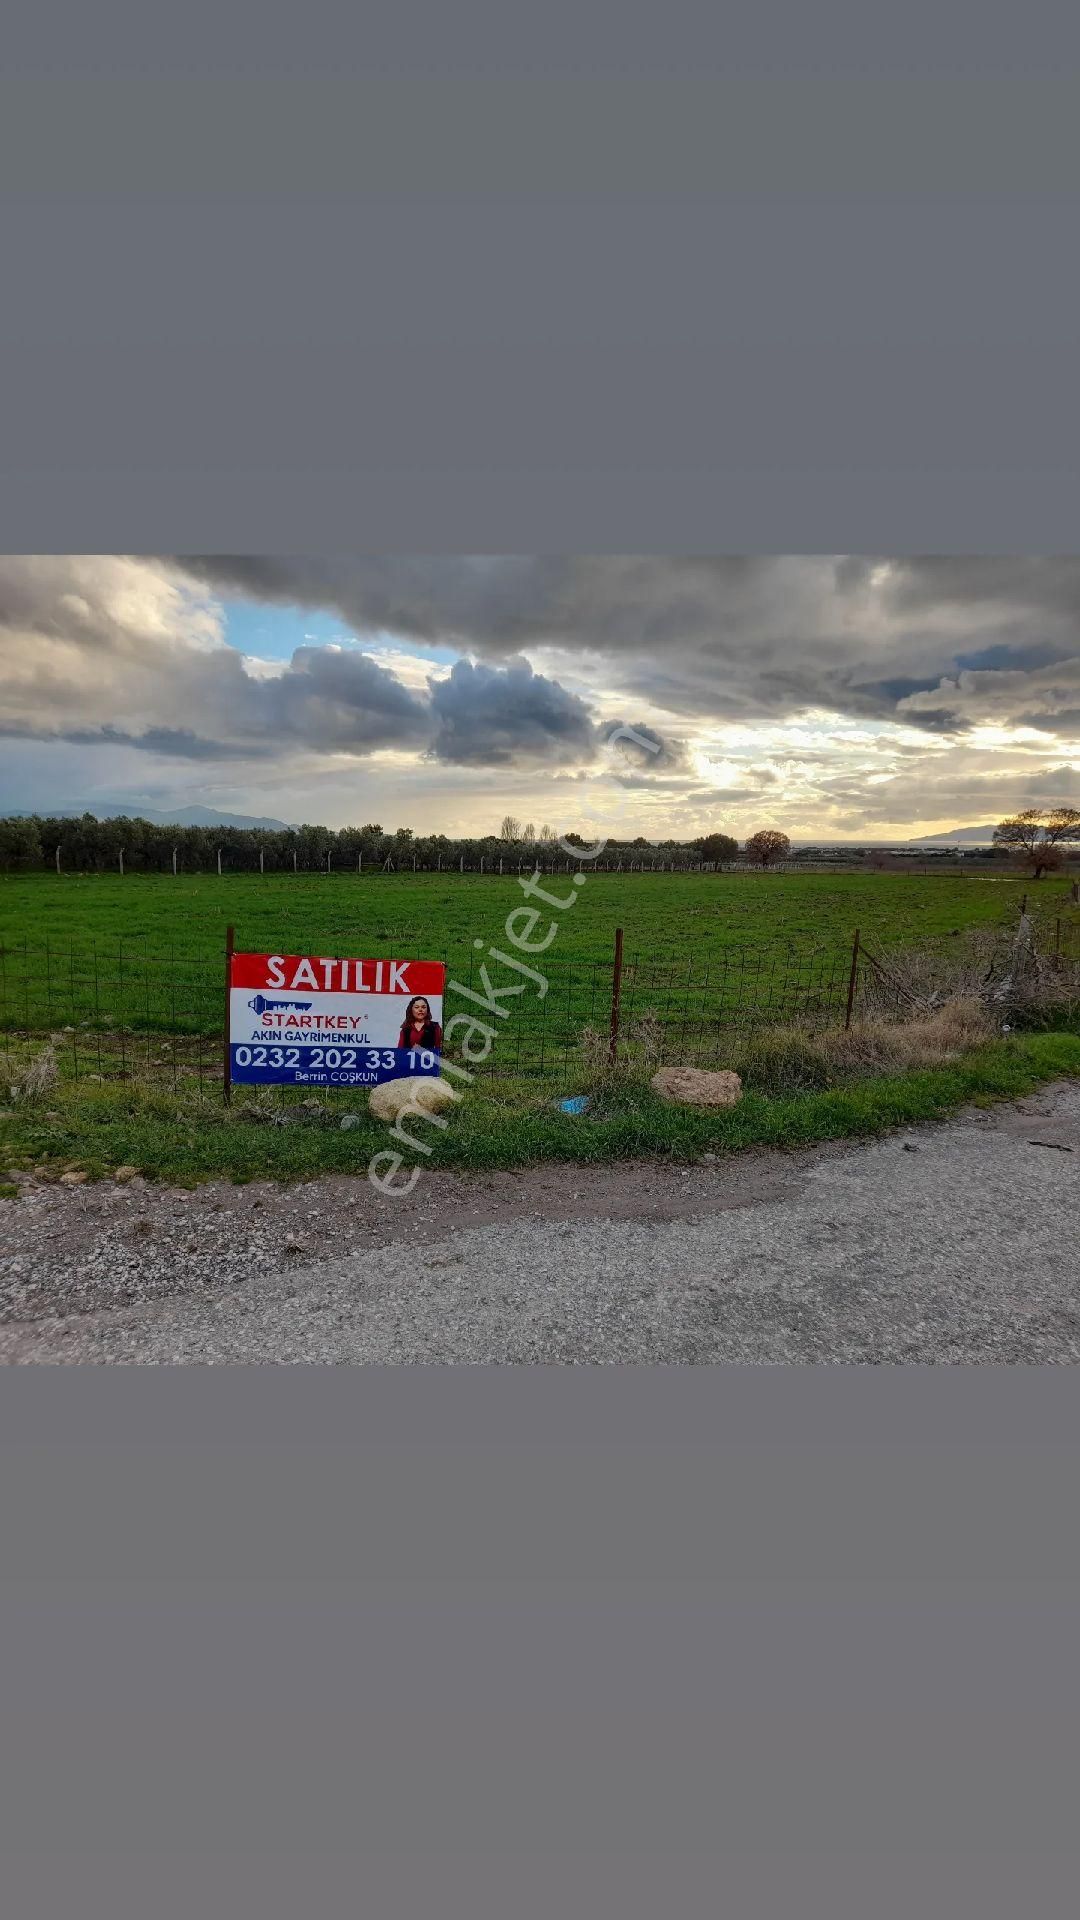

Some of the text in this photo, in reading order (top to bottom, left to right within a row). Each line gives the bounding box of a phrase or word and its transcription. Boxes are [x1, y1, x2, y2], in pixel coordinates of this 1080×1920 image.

[266, 956, 411, 993] SATILIK
[262, 1013, 361, 1029] STARTKEY
[251, 1030, 370, 1044] AKIN GAYRİMENKUL
[236, 1047, 435, 1069] 0232 202 33 10
[295, 1072, 378, 1083] Berrin COŞKUN
